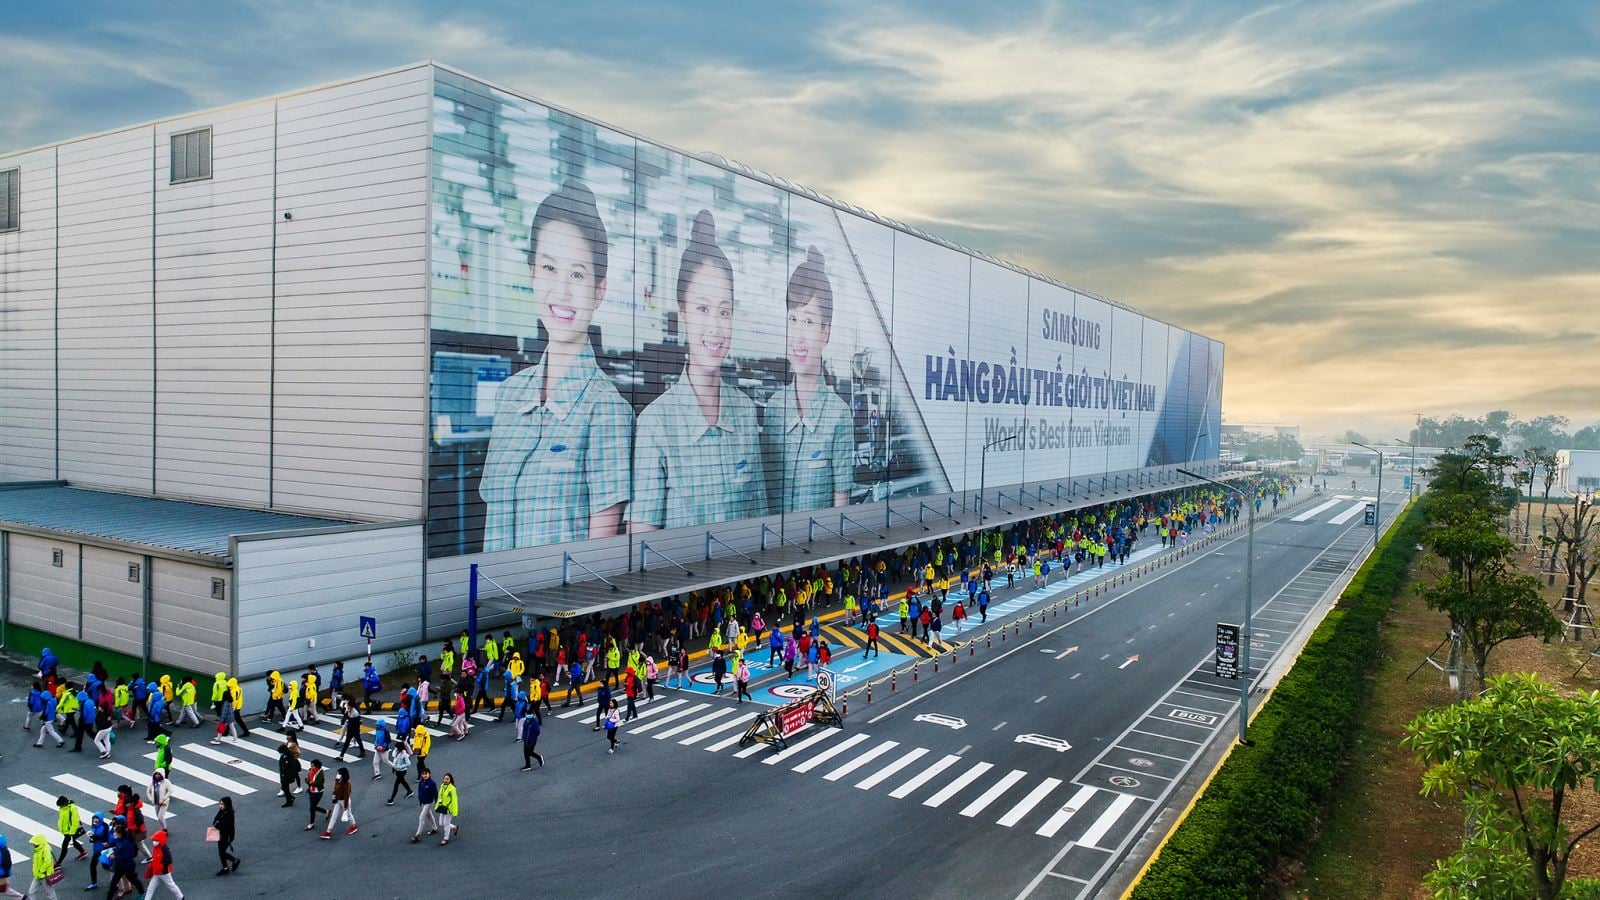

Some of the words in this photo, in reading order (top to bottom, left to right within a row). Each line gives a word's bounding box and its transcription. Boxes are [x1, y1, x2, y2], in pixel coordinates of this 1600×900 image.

[1043, 308, 1100, 350] SAMSUNG
[925, 345, 990, 404] HÀNG
[992, 345, 1032, 406] ĐẦU
[1034, 354, 1063, 406] THẾ
[1065, 366, 1093, 409] GIỚI
[1093, 369, 1110, 410] TỪ
[1111, 373, 1135, 419] VIỆT
[1134, 383, 1156, 412] NAM
[984, 417, 1036, 452] World's
[1039, 418, 1066, 450] Best
[1067, 418, 1092, 448] from
[1094, 419, 1131, 447] Vietnam
[819, 676, 828, 687] 20
[1178, 712, 1208, 721] BUS
